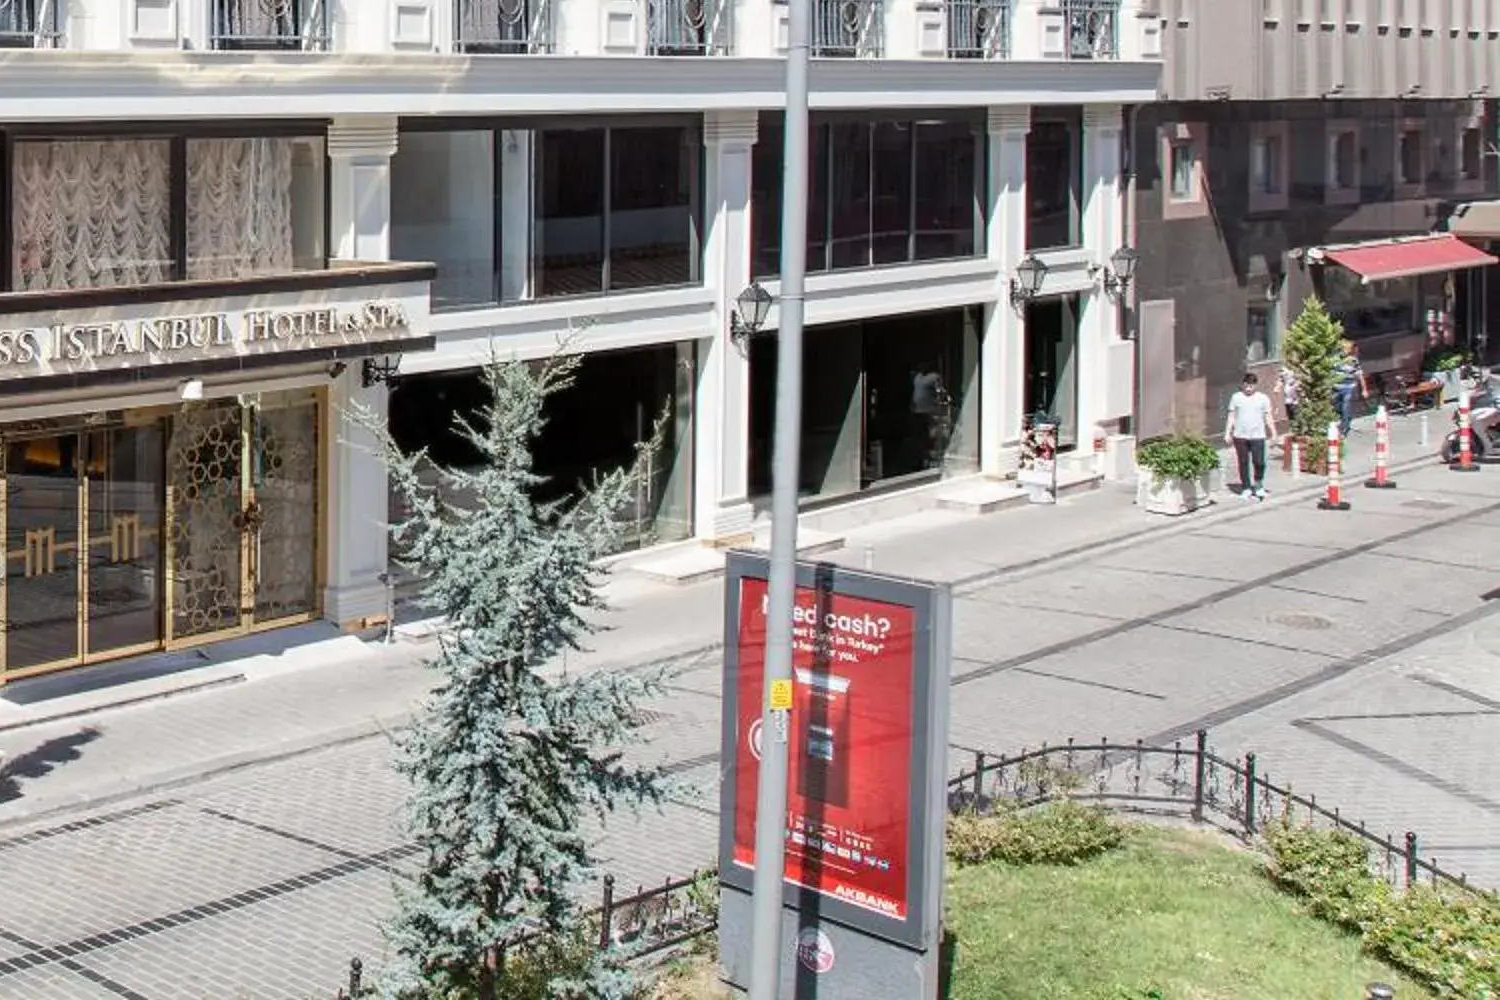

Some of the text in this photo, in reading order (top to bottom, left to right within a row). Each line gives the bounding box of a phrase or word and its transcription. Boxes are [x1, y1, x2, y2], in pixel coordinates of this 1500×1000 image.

[245, 309, 337, 341] HOTEL
[345, 317, 359, 331] &
[363, 301, 408, 328] SPA
[825, 613, 891, 638] cash?
[835, 884, 899, 914] AKBANK
